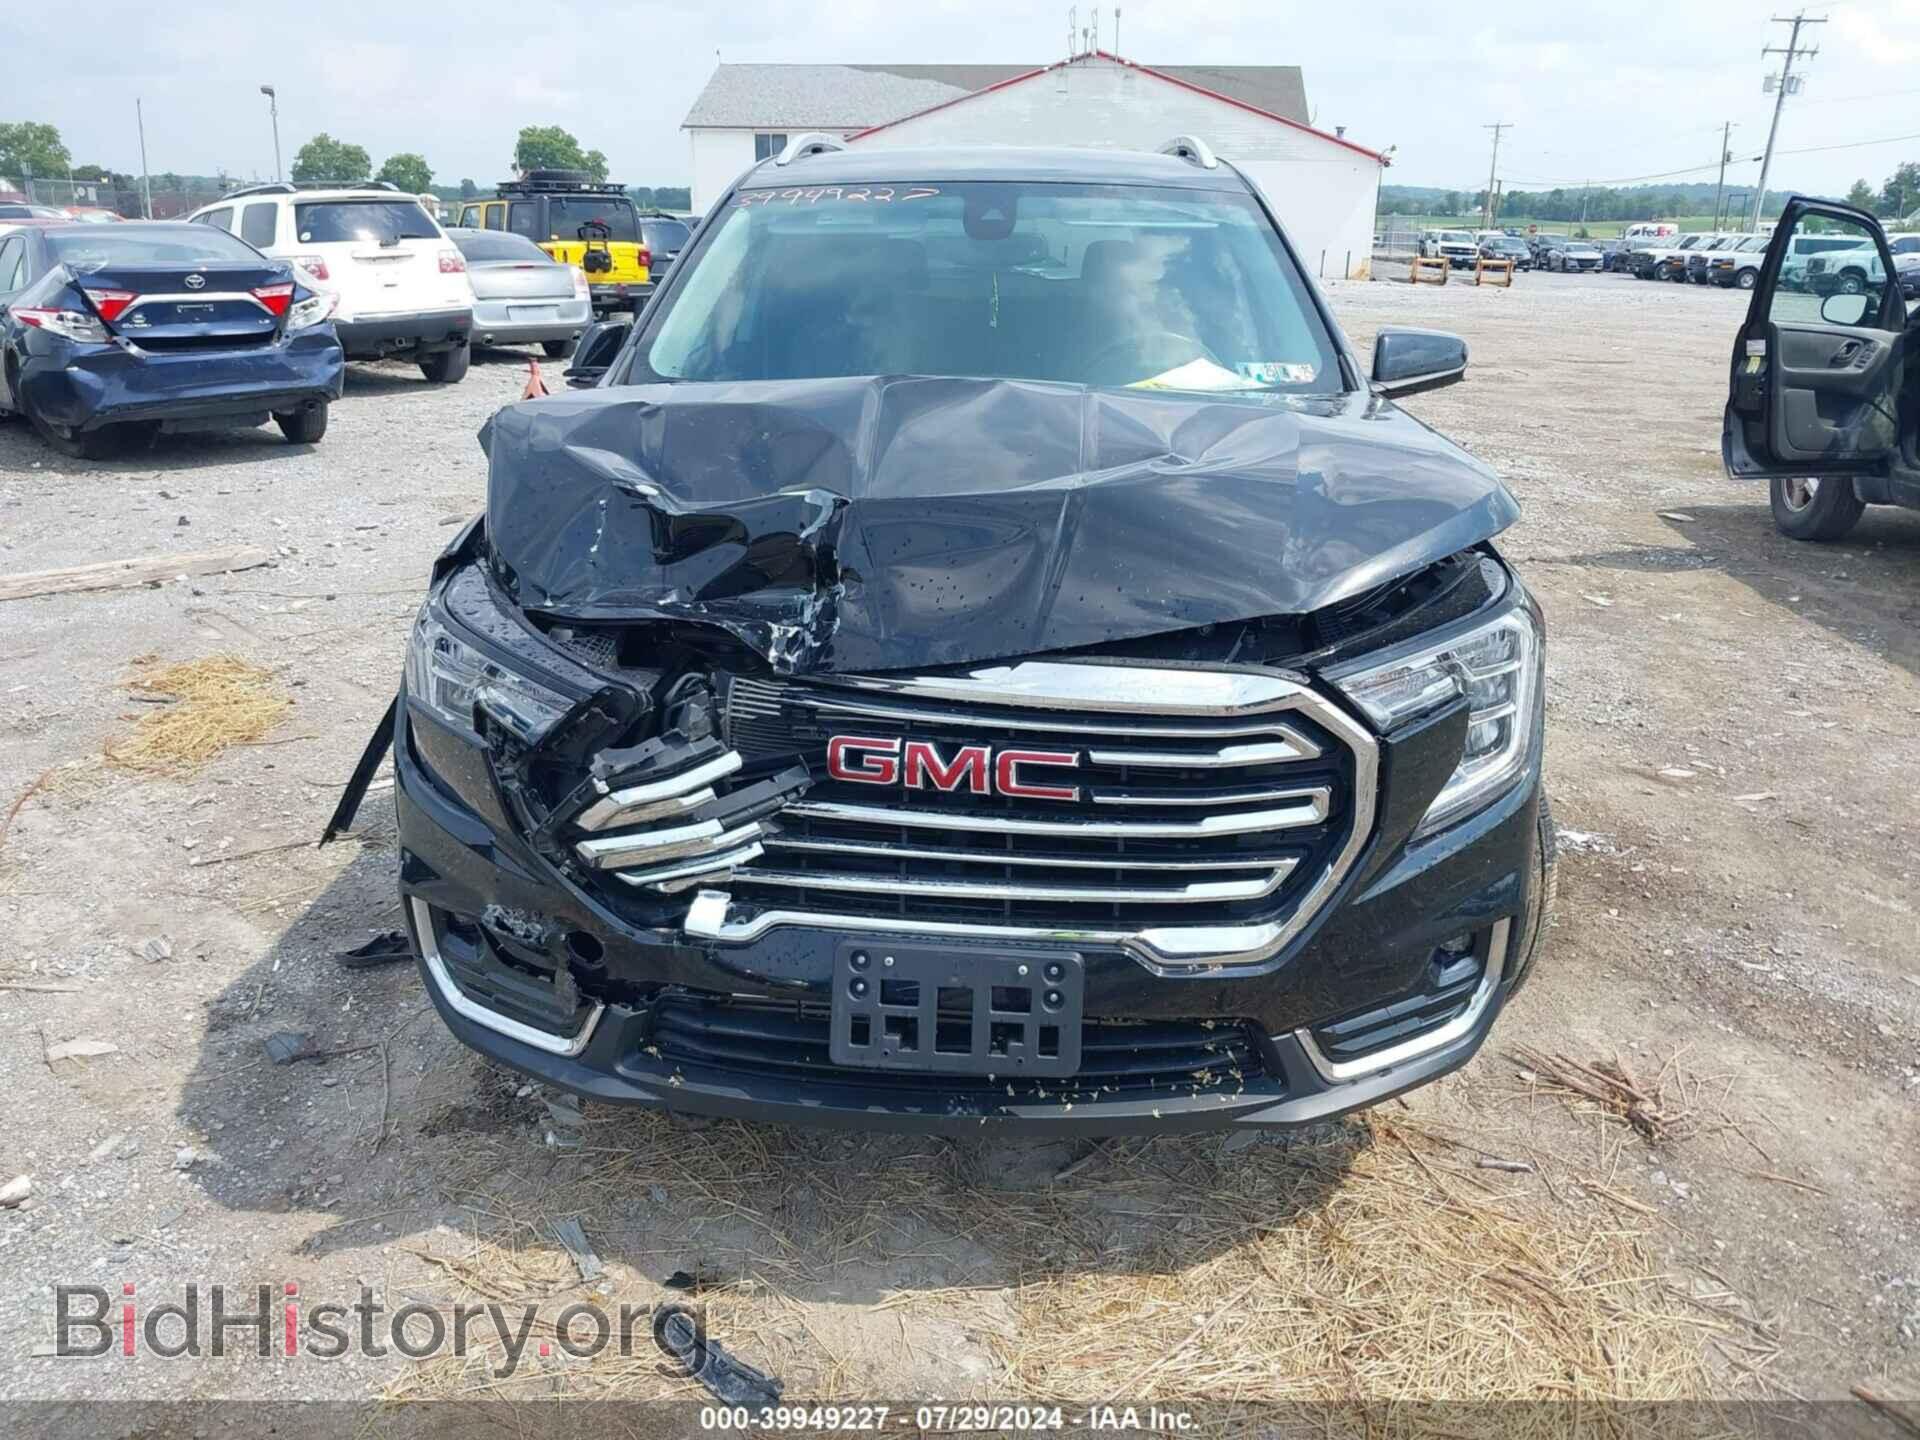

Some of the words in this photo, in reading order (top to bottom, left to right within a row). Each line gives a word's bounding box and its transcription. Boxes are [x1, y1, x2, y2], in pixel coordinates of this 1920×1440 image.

[731, 188, 940, 208] 39949227
[1642, 226, 1673, 237] FedEx
[827, 735, 1080, 802] GMC
